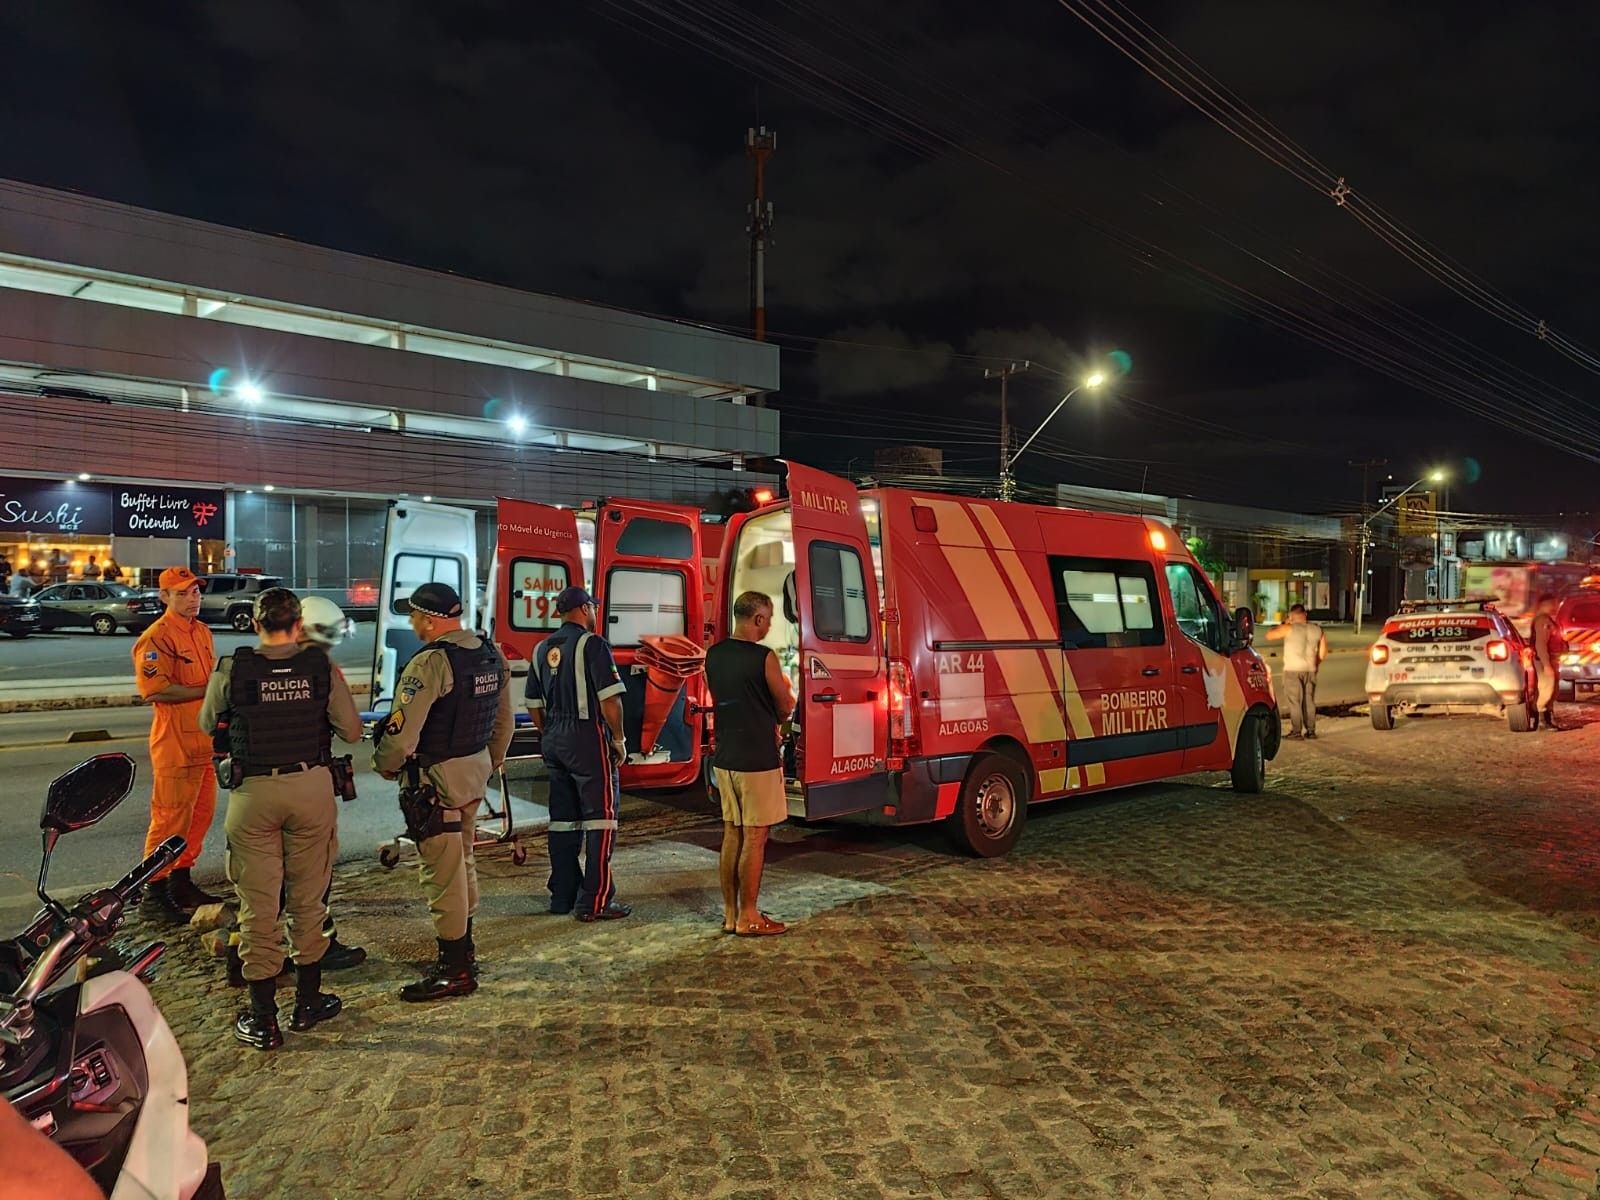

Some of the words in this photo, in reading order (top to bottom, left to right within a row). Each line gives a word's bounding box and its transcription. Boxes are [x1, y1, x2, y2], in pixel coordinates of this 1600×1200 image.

[120, 492, 158, 512] Buffet
[160, 494, 190, 509] Livre
[801, 490, 850, 516] MILITAR
[0, 501, 83, 524] Sushi
[129, 514, 180, 531] Oriental
[497, 523, 508, 531] to
[509, 523, 532, 534] Móvel
[533, 526, 543, 535] de
[544, 528, 573, 539] Urgência
[524, 577, 563, 591] SAMU
[1398, 619, 1435, 629] POLÍCIA
[1438, 618, 1478, 626] MILITAR
[1409, 627, 1462, 638] 30-1383
[939, 654, 963, 673] AR
[967, 653, 985, 672] 44
[261, 678, 310, 691] POLÍCIA
[475, 672, 499, 685] POLÍCIA
[261, 690, 311, 703] MILITAR
[475, 682, 498, 694] MILITAR
[1101, 689, 1167, 711] BOMBEIRO
[939, 719, 989, 736] ALAGOAS
[1102, 707, 1168, 736] MILITAR
[830, 755, 875, 774] ALAGOAS
